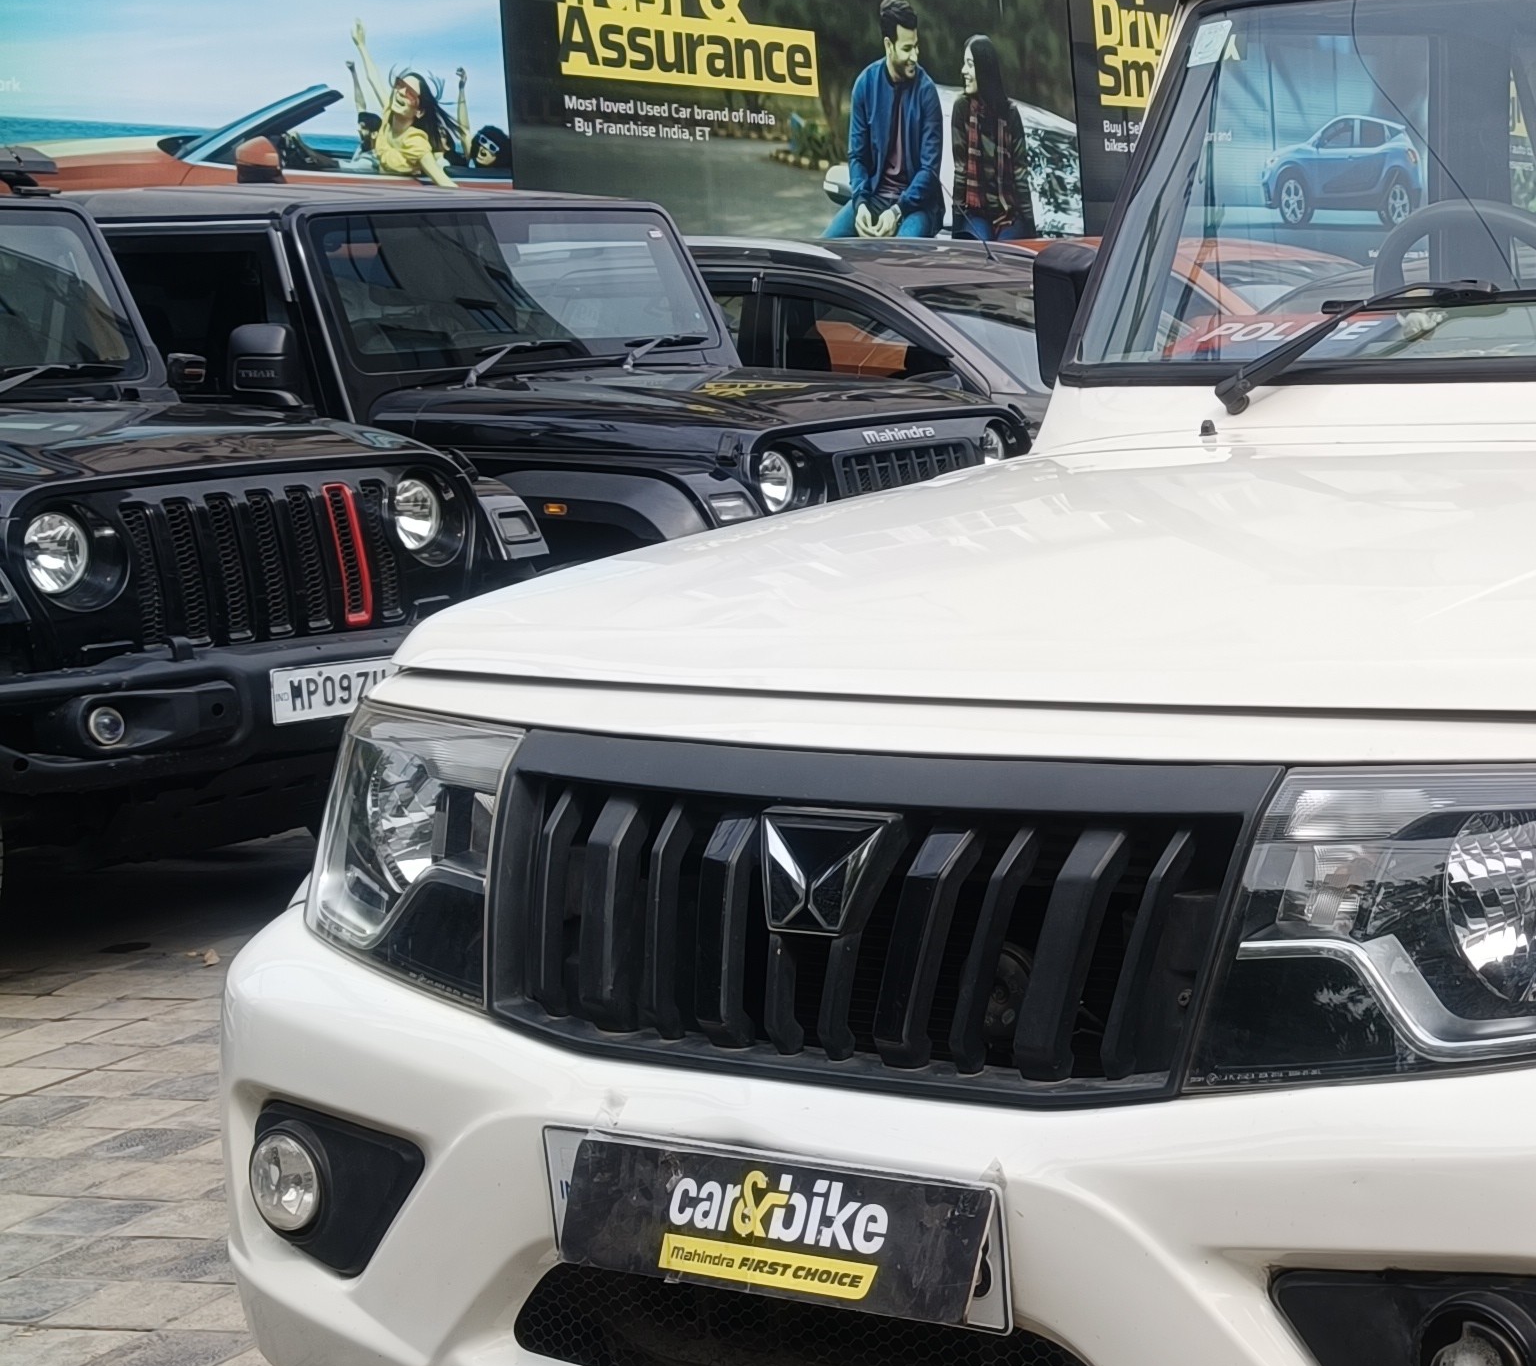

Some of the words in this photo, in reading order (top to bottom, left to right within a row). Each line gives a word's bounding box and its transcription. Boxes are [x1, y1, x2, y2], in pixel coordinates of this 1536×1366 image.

[559, 5, 813, 86] Assurance
[563, 94, 597, 112] Most
[600, 96, 634, 115] loved
[637, 101, 669, 117] Used
[671, 103, 691, 119] Car
[694, 105, 729, 122] brand
[731, 108, 745, 123] of
[747, 111, 776, 126] India
[574, 118, 593, 137] By
[596, 119, 657, 138] Franchise
[659, 124, 694, 142] India,
[696, 126, 711, 141] ET
[1103, 120, 1122, 136] Buy
[1104, 138, 1129, 153] bikes
[862, 426, 936, 444] Mahindra
[275, 691, 290, 702] IND
[669, 1170, 889, 1255] car&bike
[671, 1245, 735, 1269] Mahindra
[737, 1255, 792, 1278] FIRST
[792, 1265, 864, 1289] CHOICE
